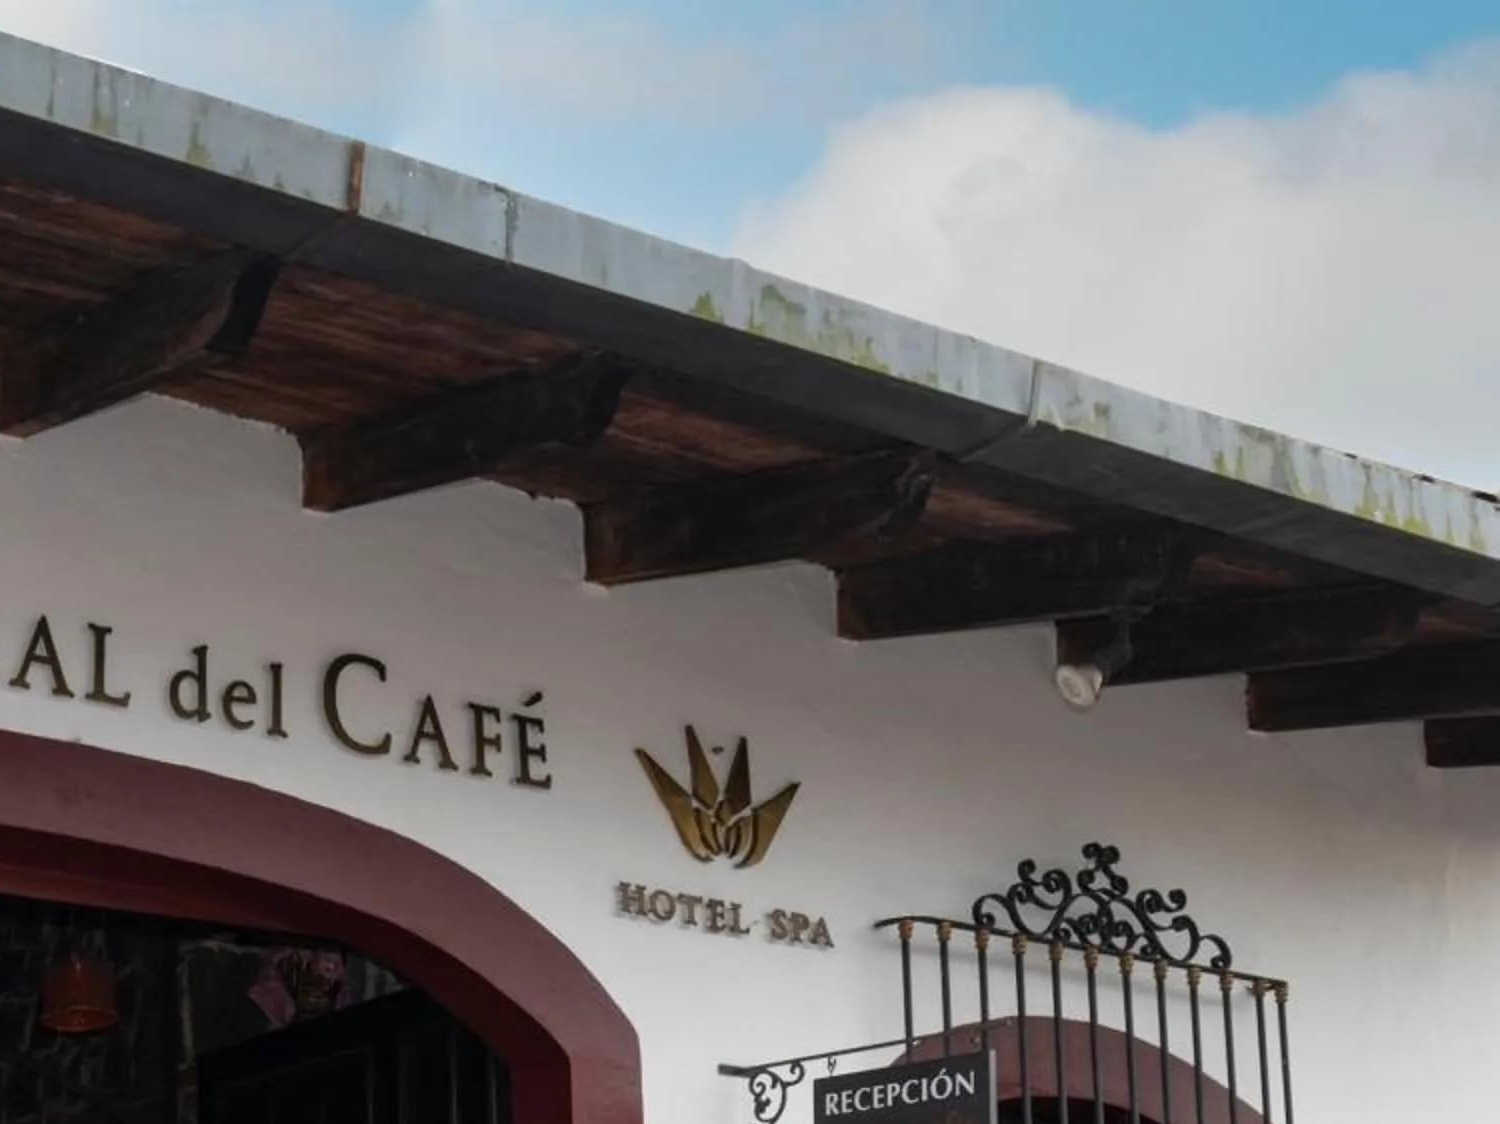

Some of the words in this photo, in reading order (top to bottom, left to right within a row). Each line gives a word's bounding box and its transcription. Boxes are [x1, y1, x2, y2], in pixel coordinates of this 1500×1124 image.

[168, 643, 289, 740] del
[320, 651, 554, 792] CAFÉ
[616, 881, 750, 935] HOTEL
[768, 908, 835, 949] SPA
[824, 1067, 975, 1117] RECEPCIÓN
